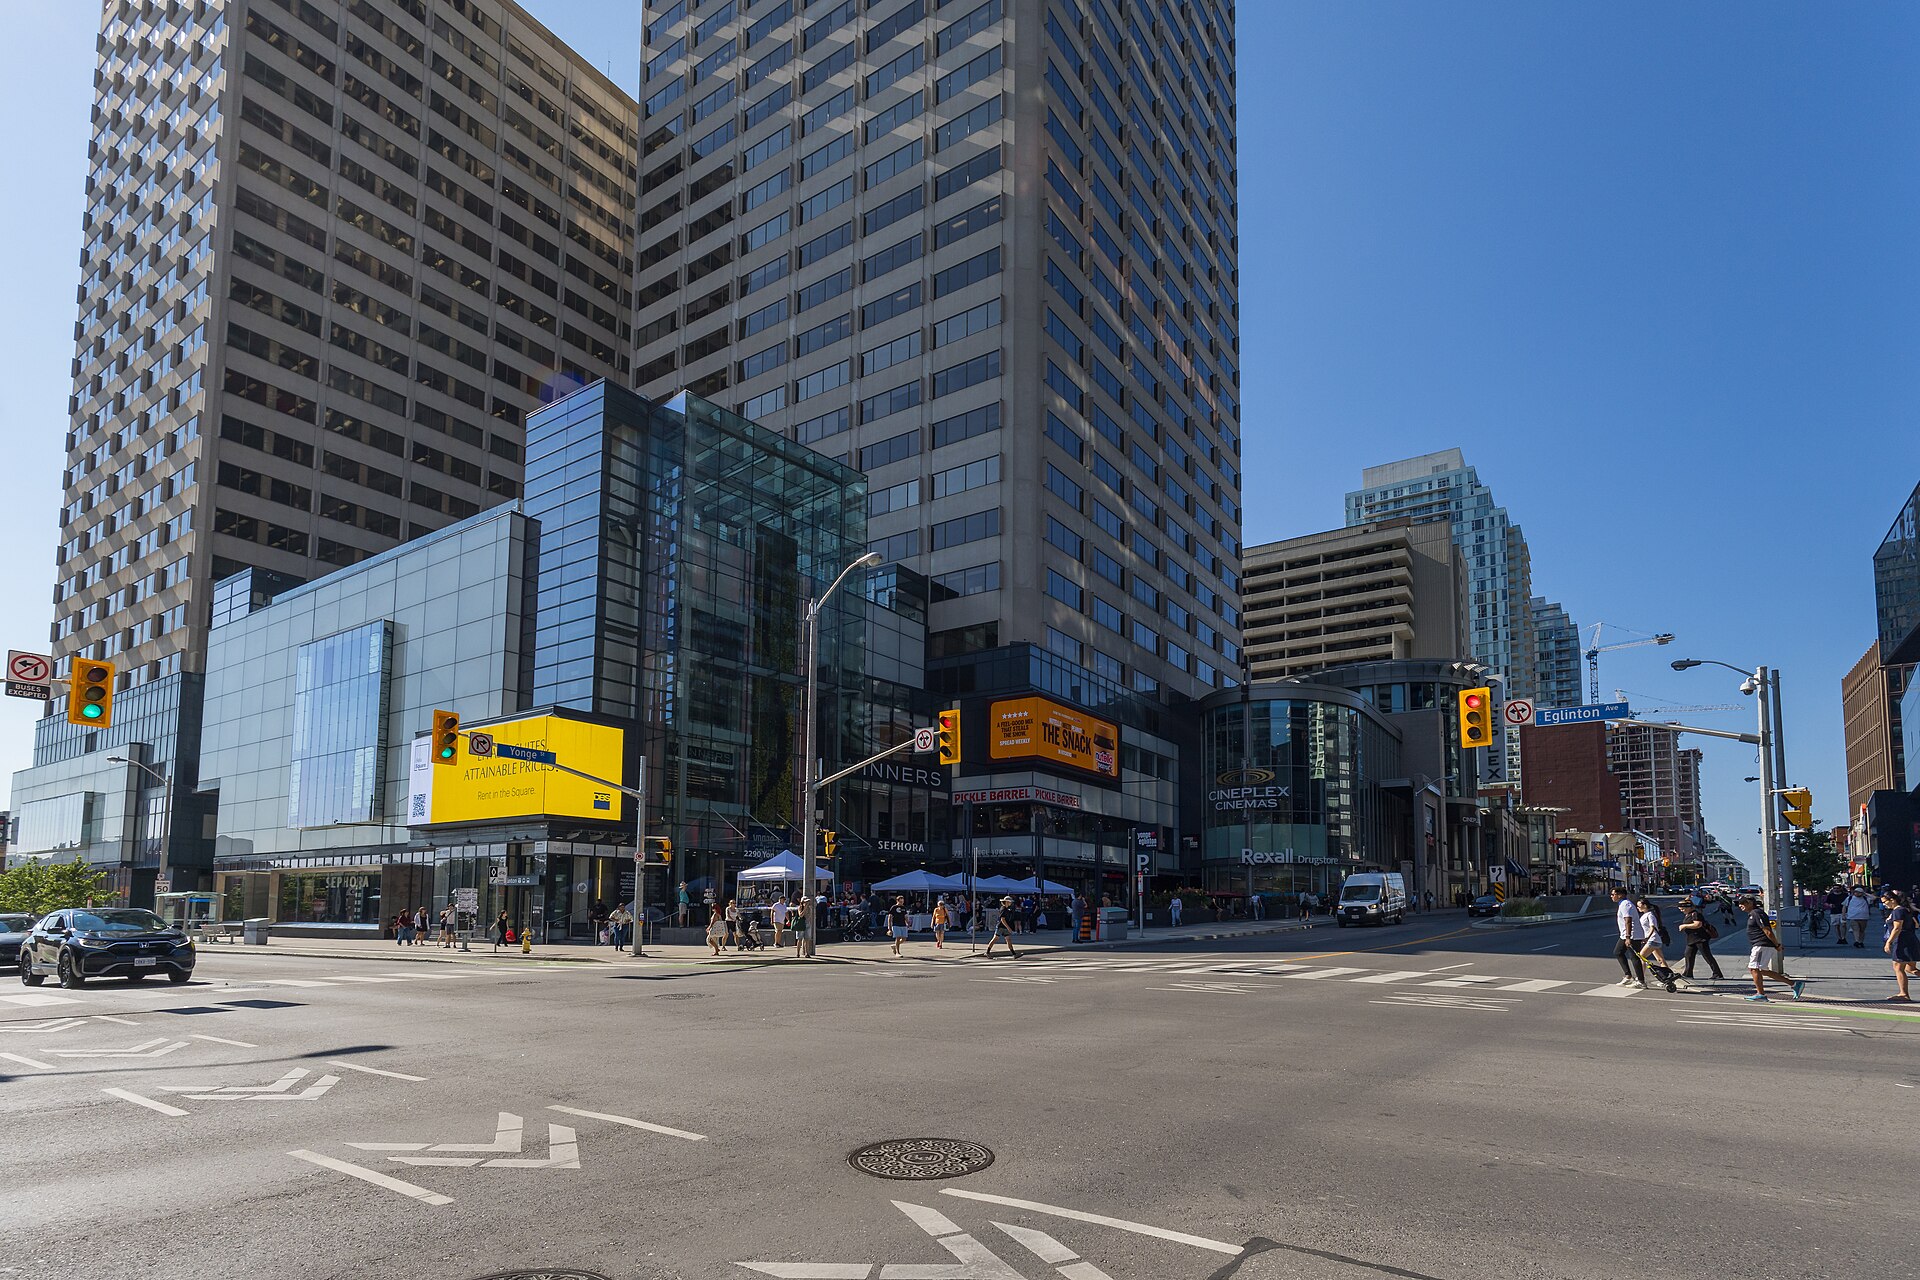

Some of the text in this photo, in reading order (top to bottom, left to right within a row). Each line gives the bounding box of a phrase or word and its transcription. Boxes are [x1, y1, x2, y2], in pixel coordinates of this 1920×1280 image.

[8, 688, 48, 699] EXCEPTED
[15, 683, 41, 692] BUSES
[1544, 708, 1600, 724] Eglinton
[1042, 722, 1092, 756] THE SNACK
[510, 746, 537, 760] Yonge
[464, 762, 517, 780] ATTAINABLE
[862, 762, 941, 786] INNERS
[478, 786, 536, 800] Rent in the Square.
[954, 788, 1030, 804] PICKLE BARREL
[1035, 788, 1080, 807] PICKLE BARREL
[1208, 786, 1290, 800] CINEPLEX
[1216, 798, 1278, 810] CINEMAS
[878, 840, 924, 852] SEPHORA
[744, 850, 774, 858] 2290 Yon
[1242, 848, 1338, 866] Rexall Drugstore
[1137, 854, 1150, 871] P
[326, 875, 369, 888] SEPHORA
